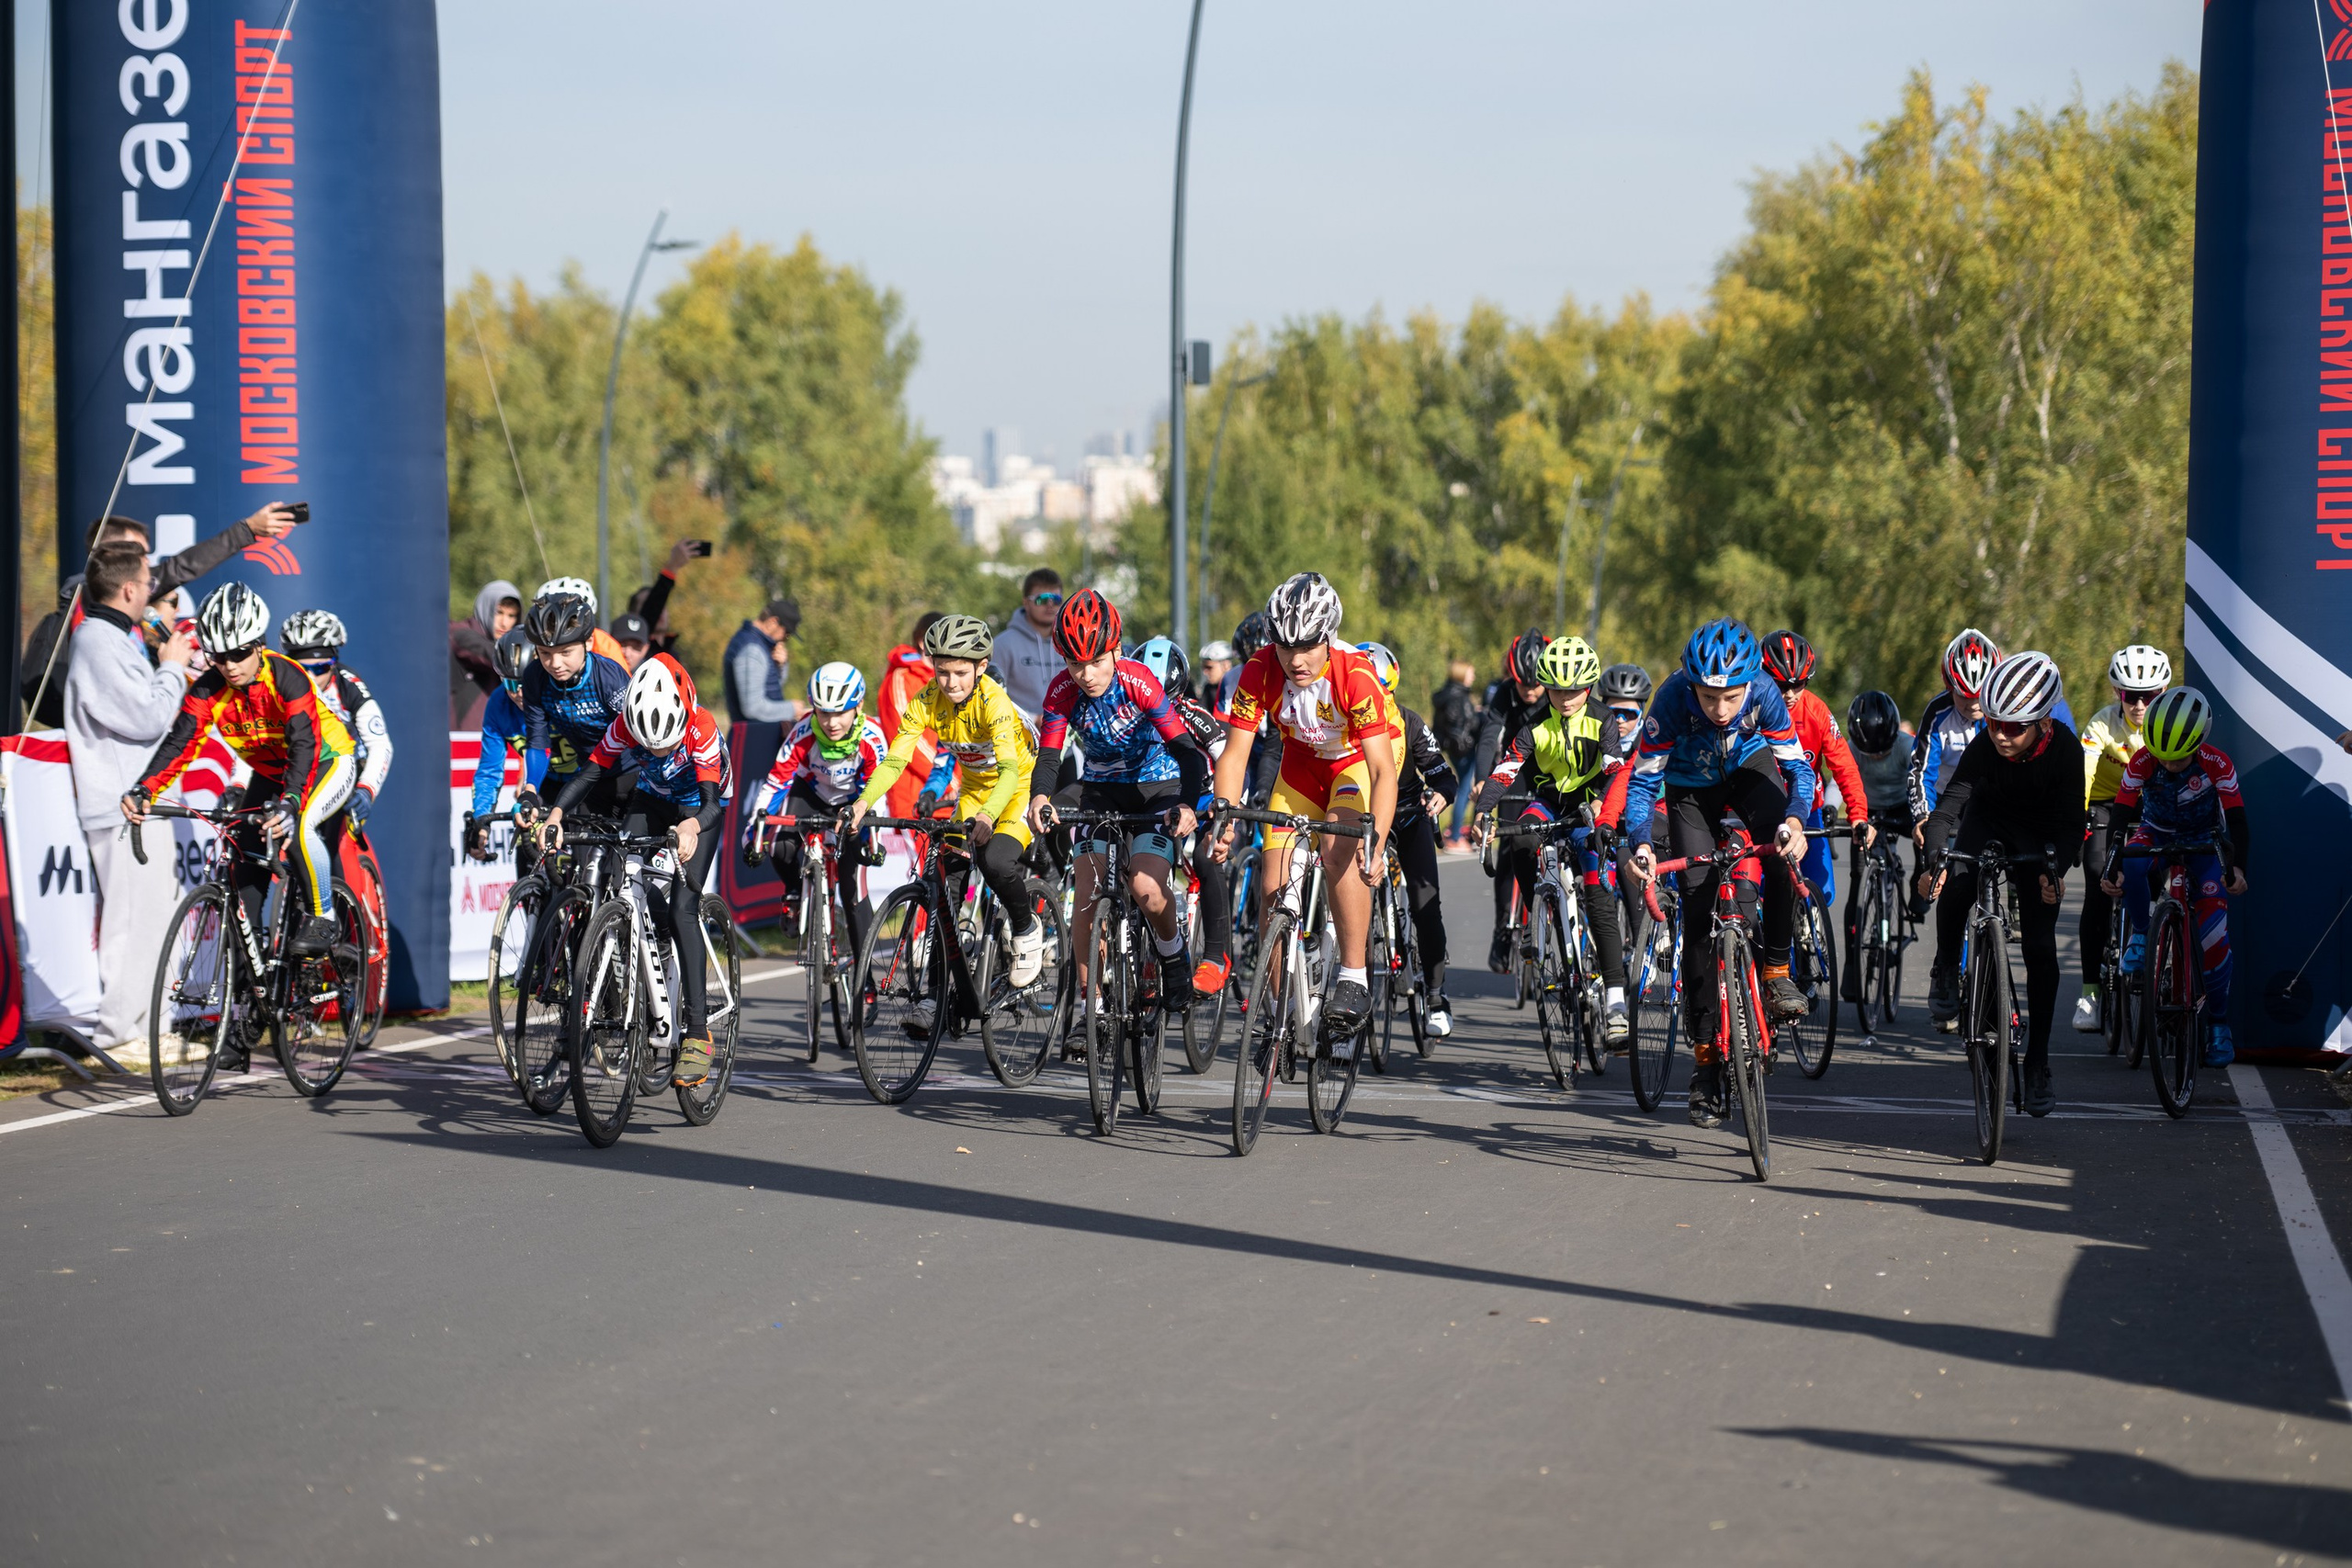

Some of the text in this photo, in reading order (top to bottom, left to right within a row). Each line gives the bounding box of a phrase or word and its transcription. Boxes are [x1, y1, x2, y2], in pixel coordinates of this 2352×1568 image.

[223, 19, 299, 484] МОСКОВСКИЙ СПОРТ
[641, 910, 671, 1009] SCOTT
